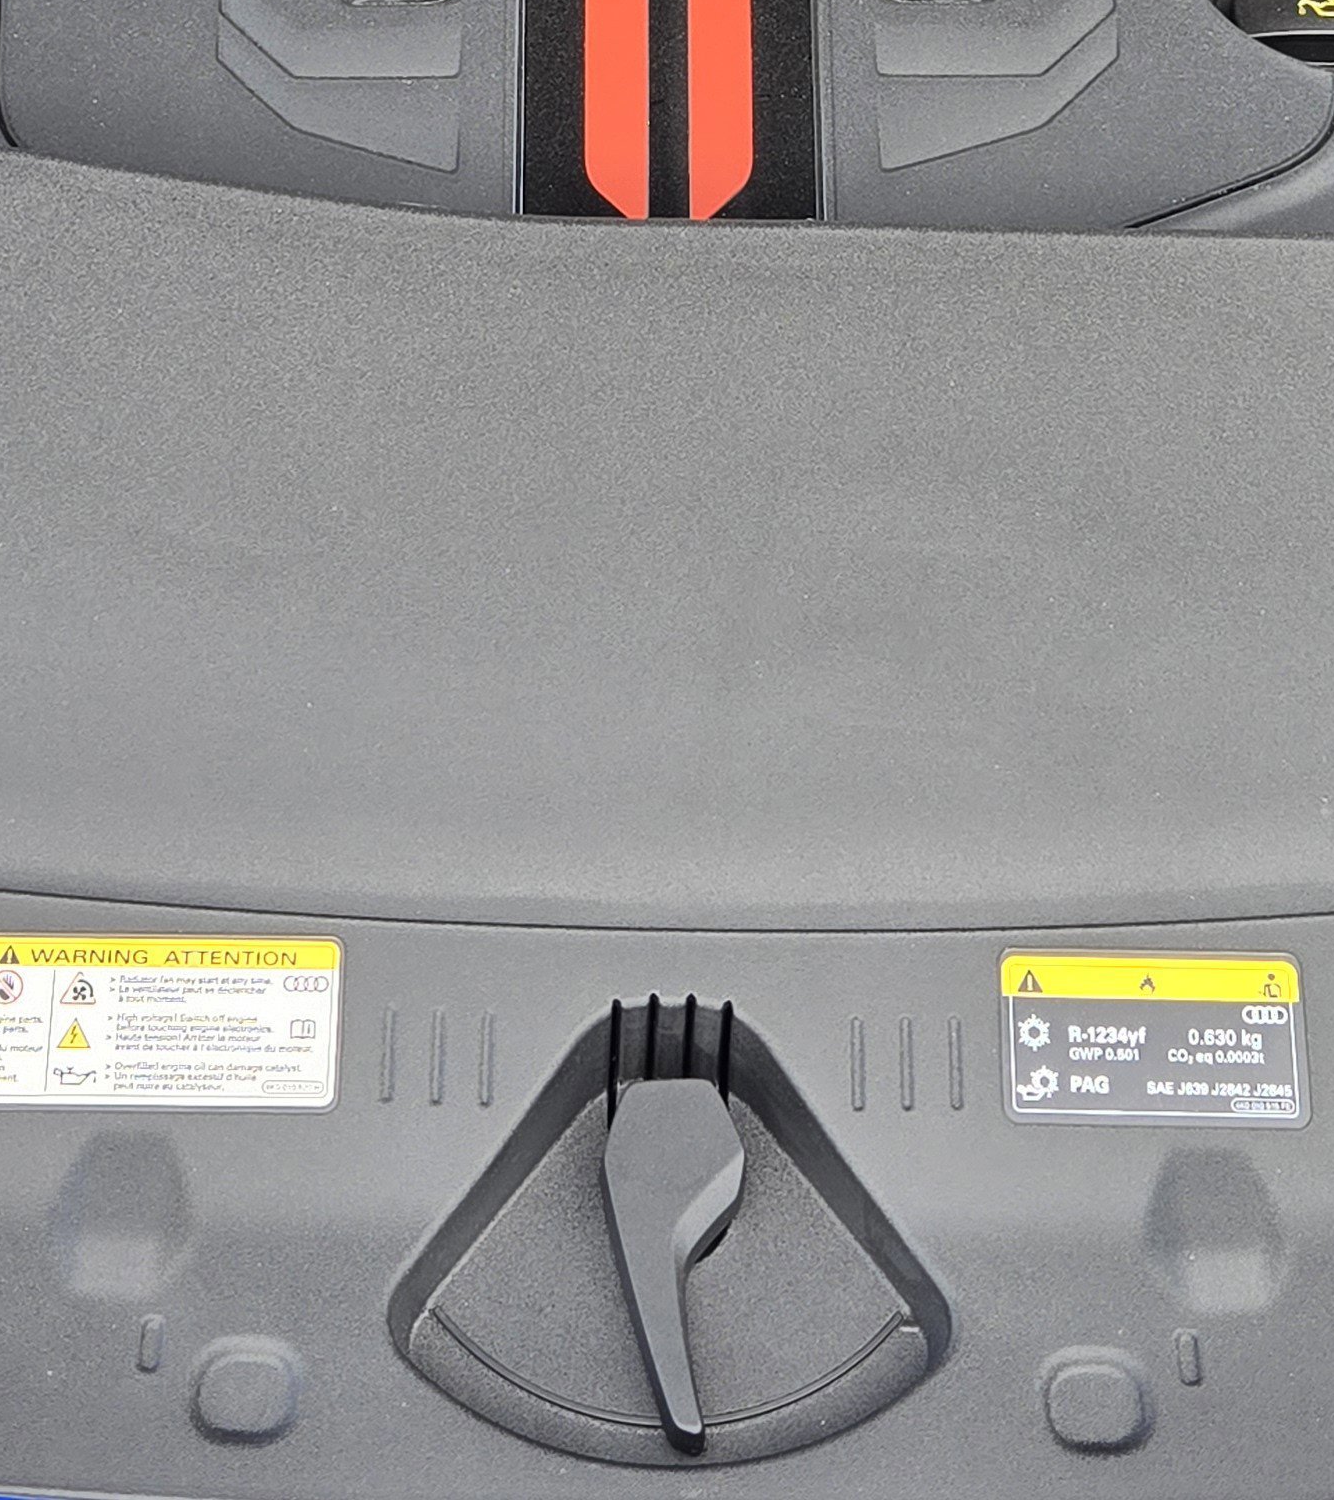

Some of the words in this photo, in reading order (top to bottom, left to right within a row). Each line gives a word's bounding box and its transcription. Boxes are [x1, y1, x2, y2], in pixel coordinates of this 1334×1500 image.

[31, 949, 148, 964] WARNING
[164, 950, 297, 965] ATTENTION
[1068, 1026, 1146, 1045] R-1234yf
[1188, 1028, 1237, 1046] 0.630
[1242, 1029, 1262, 1050] kg
[1069, 1049, 1102, 1061] GWP
[1105, 1049, 1140, 1061] 0.501
[1195, 1052, 1213, 1064] eq
[1069, 1075, 1110, 1094] PAG
[1147, 1080, 1174, 1095] SAE
[1177, 1082, 1209, 1095] J639
[1211, 1083, 1251, 1096] J2842
[1253, 1083, 1294, 1097] J2845
